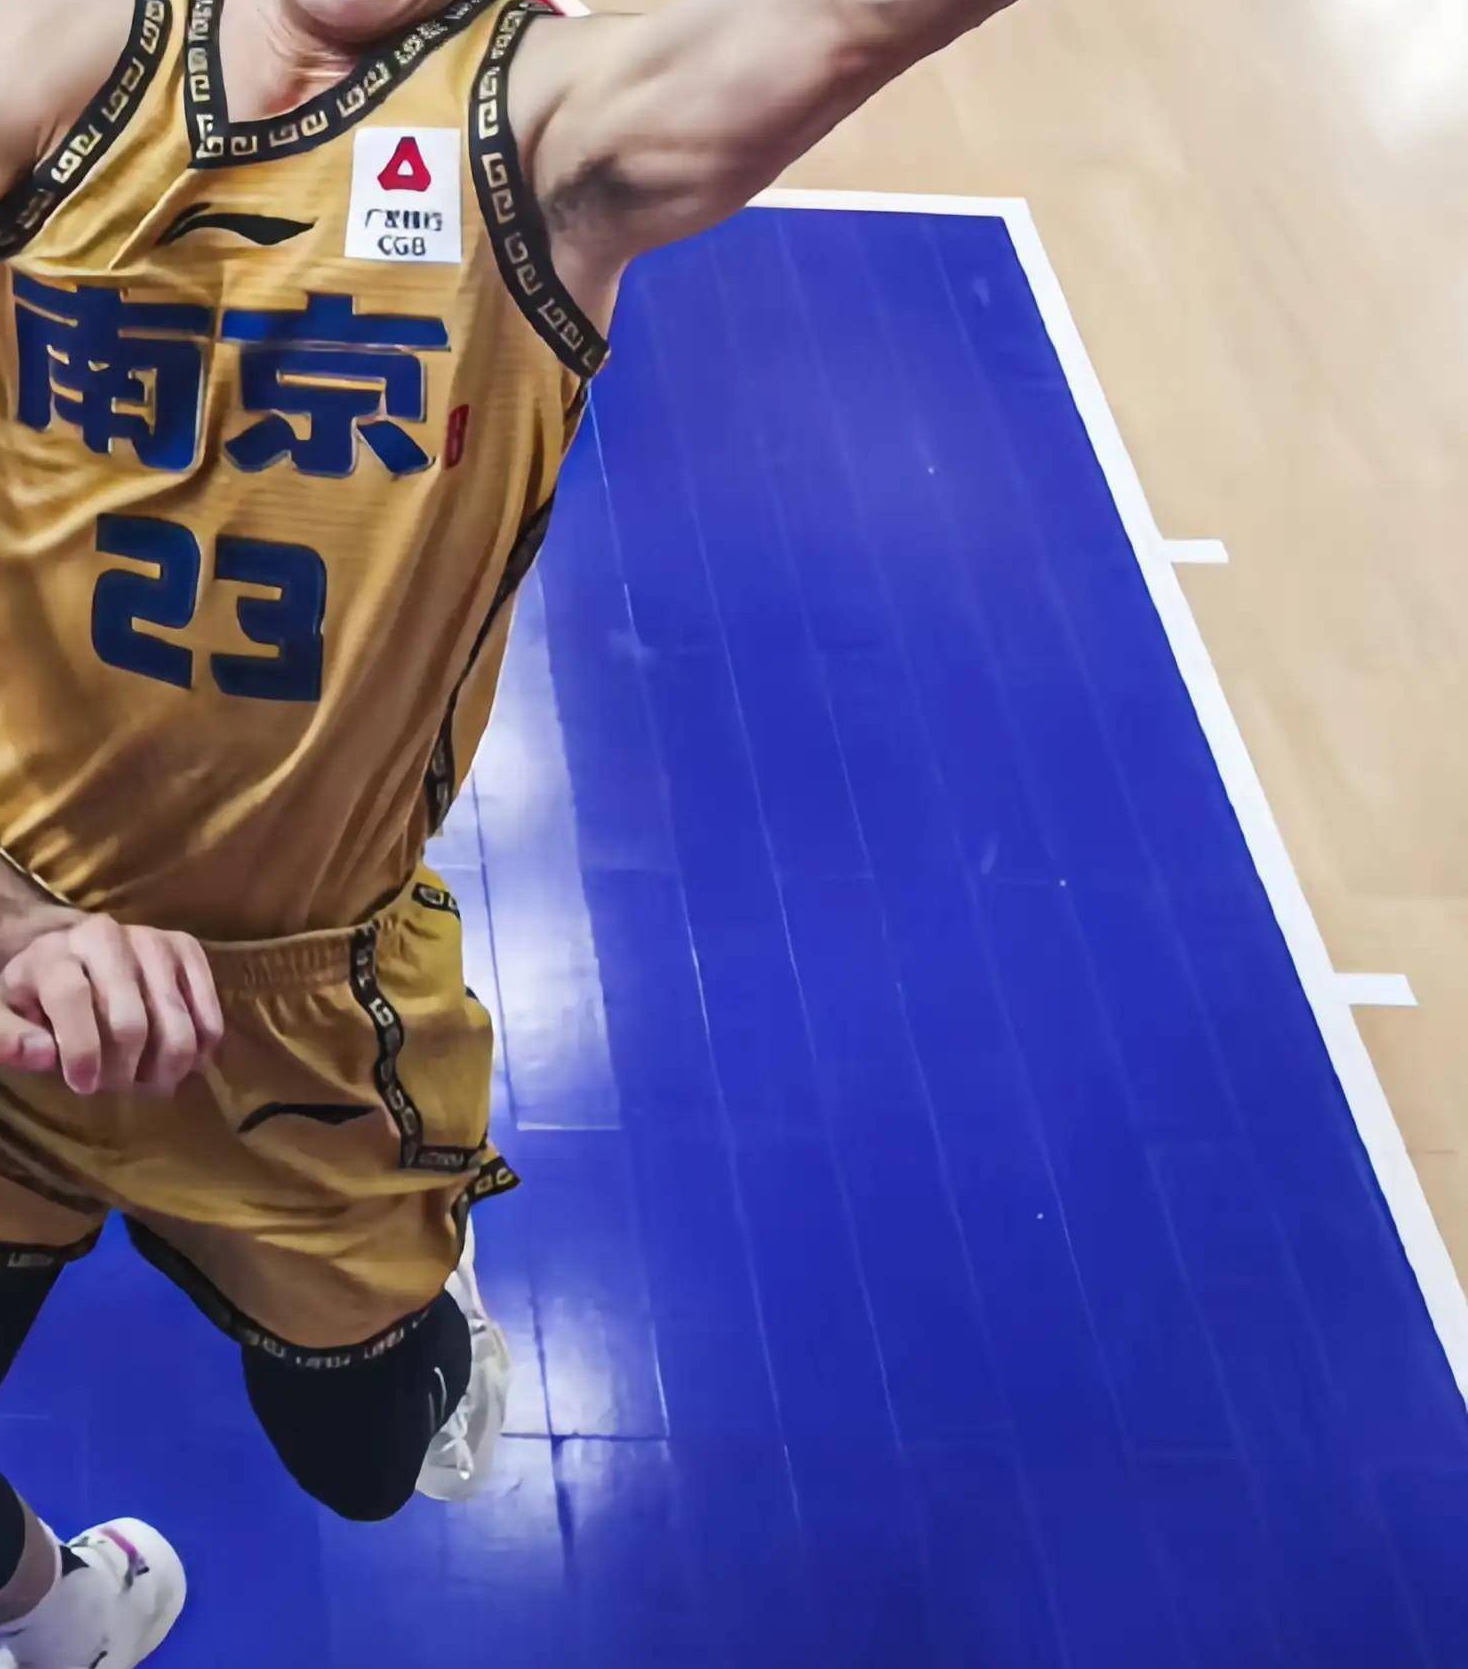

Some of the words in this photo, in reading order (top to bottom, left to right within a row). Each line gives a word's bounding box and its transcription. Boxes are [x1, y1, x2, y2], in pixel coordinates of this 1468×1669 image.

[377, 235, 427, 257] CGB
[12, 270, 451, 482] 南京
[92, 514, 328, 702] 23
